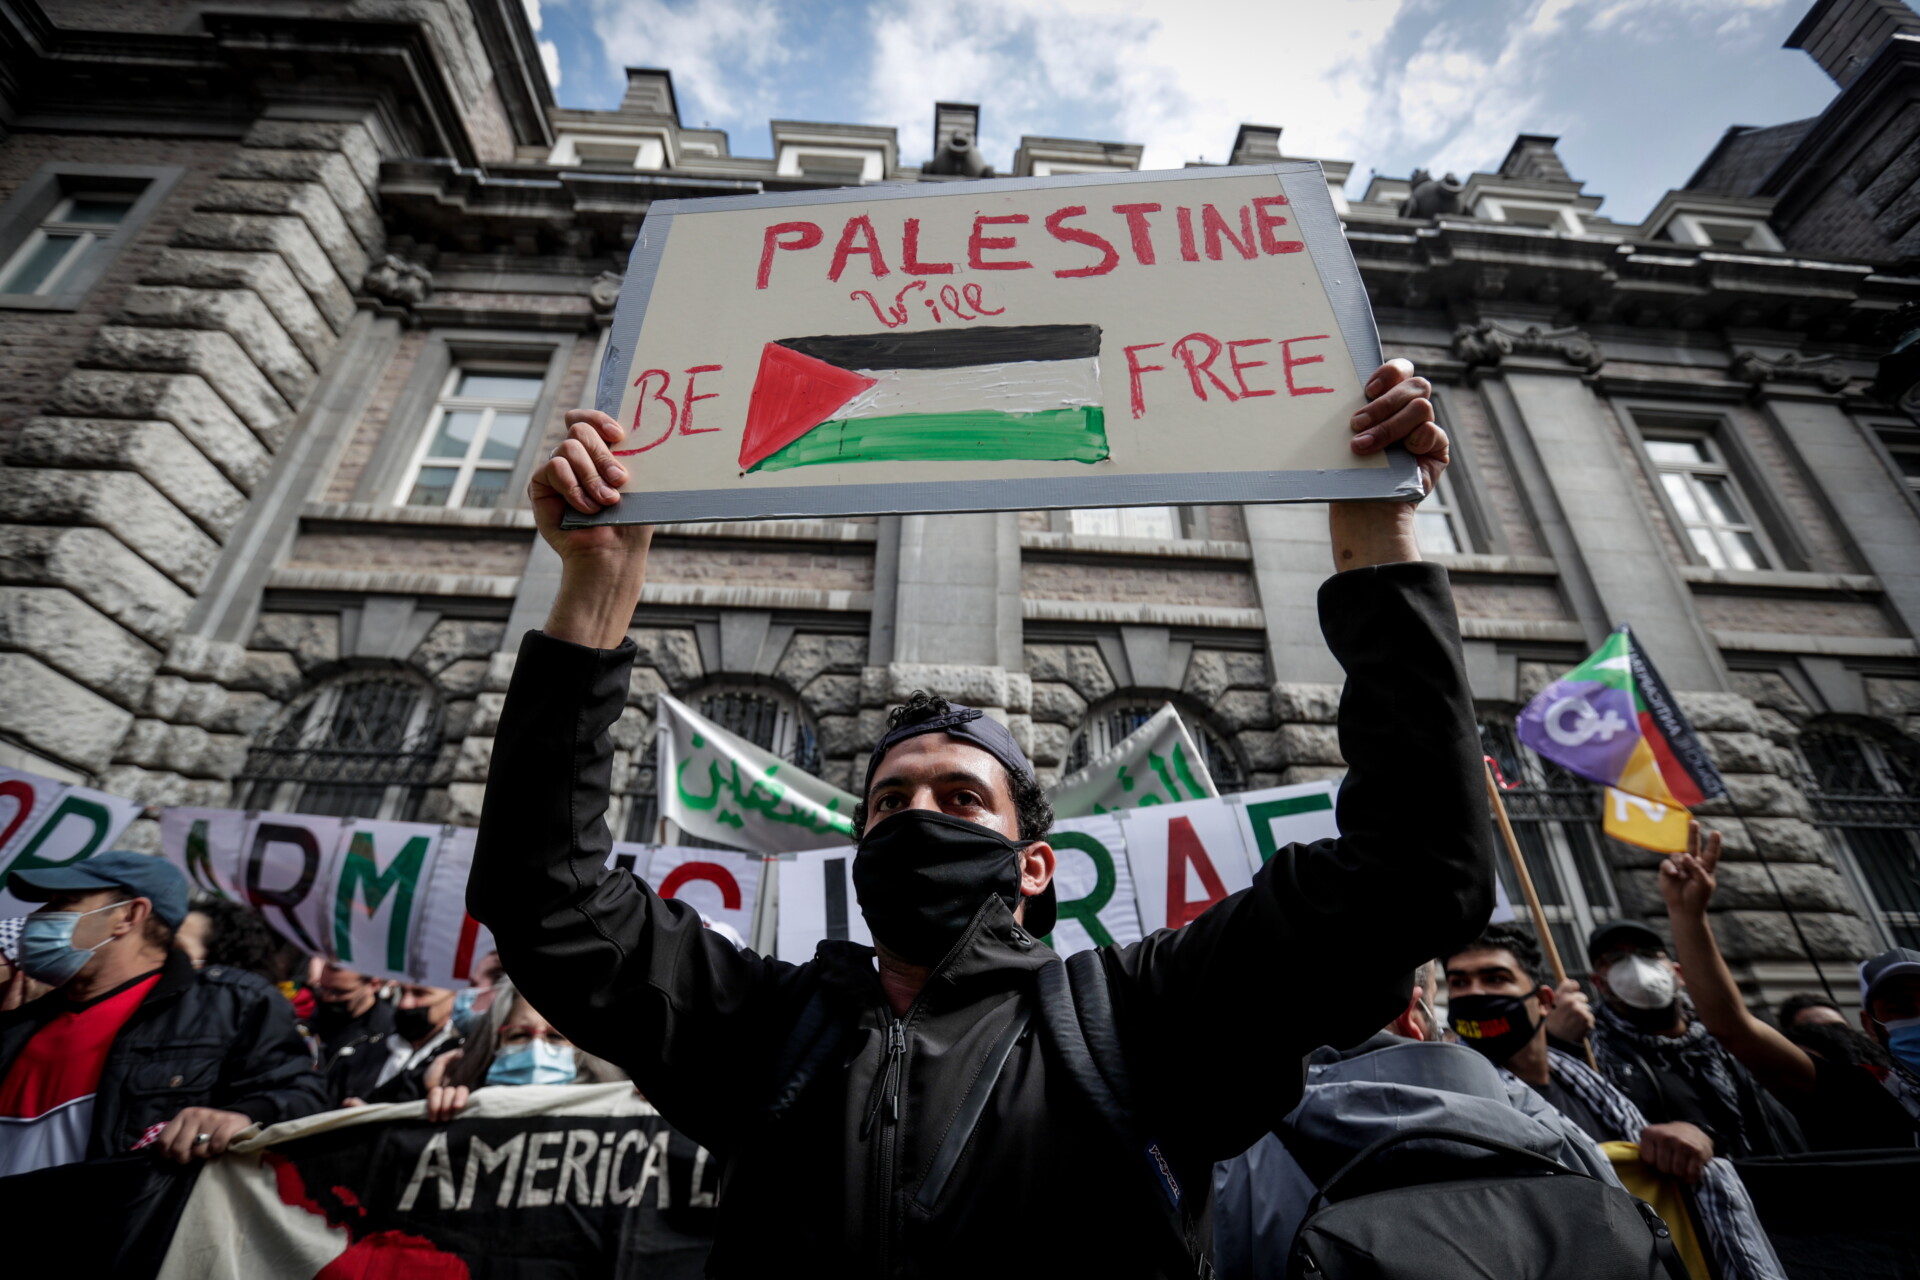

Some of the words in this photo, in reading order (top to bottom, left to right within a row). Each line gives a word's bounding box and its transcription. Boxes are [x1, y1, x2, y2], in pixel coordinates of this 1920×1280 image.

[756, 195, 1304, 289] PALESTINE
[850, 279, 1007, 332] Will
[612, 363, 725, 457] BE
[1123, 333, 1337, 421] FREE
